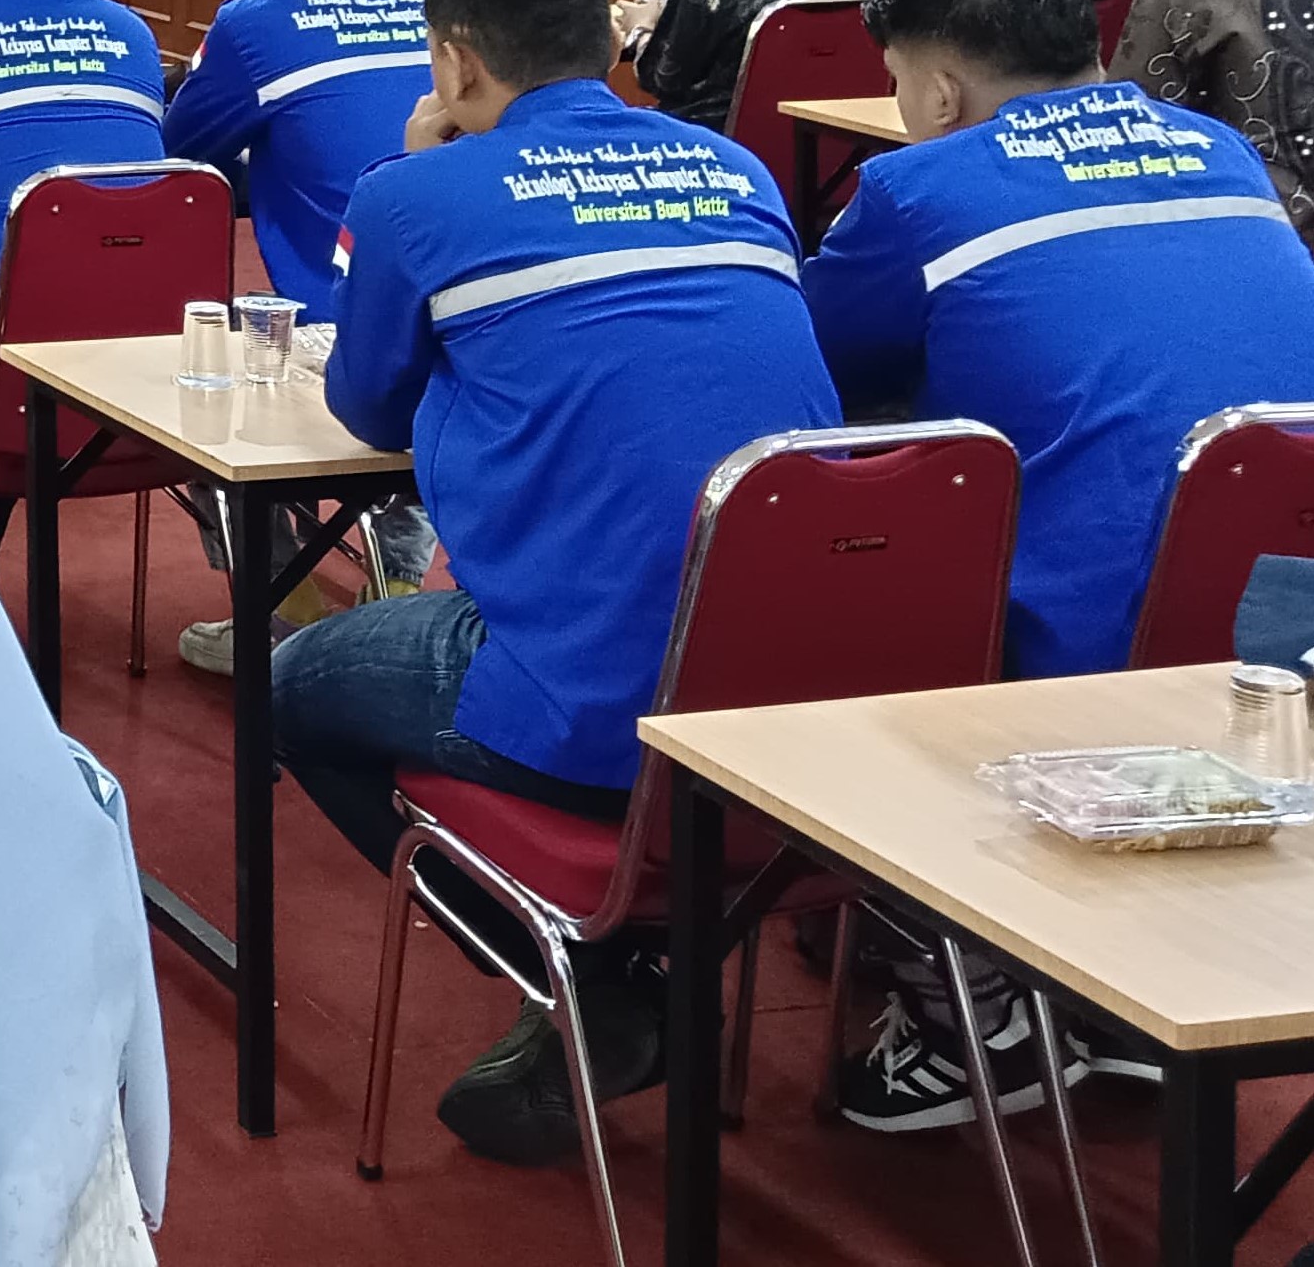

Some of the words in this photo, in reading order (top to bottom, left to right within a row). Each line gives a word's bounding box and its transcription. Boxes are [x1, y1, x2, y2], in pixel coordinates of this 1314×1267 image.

[336, 30, 390, 45] Universitas
[53, 59, 77, 74] Bung
[80, 58, 106, 73] Hatta
[519, 146, 594, 165] Fakultas
[995, 132, 1065, 161] Teknologi
[1062, 160, 1139, 182] Universitas
[503, 169, 577, 202] Teknologi
[572, 168, 640, 196] Rekayasa
[635, 165, 705, 193] Komputer
[572, 202, 652, 224] Universitas
[655, 199, 691, 222] Bung
[693, 196, 730, 217] Hatta
